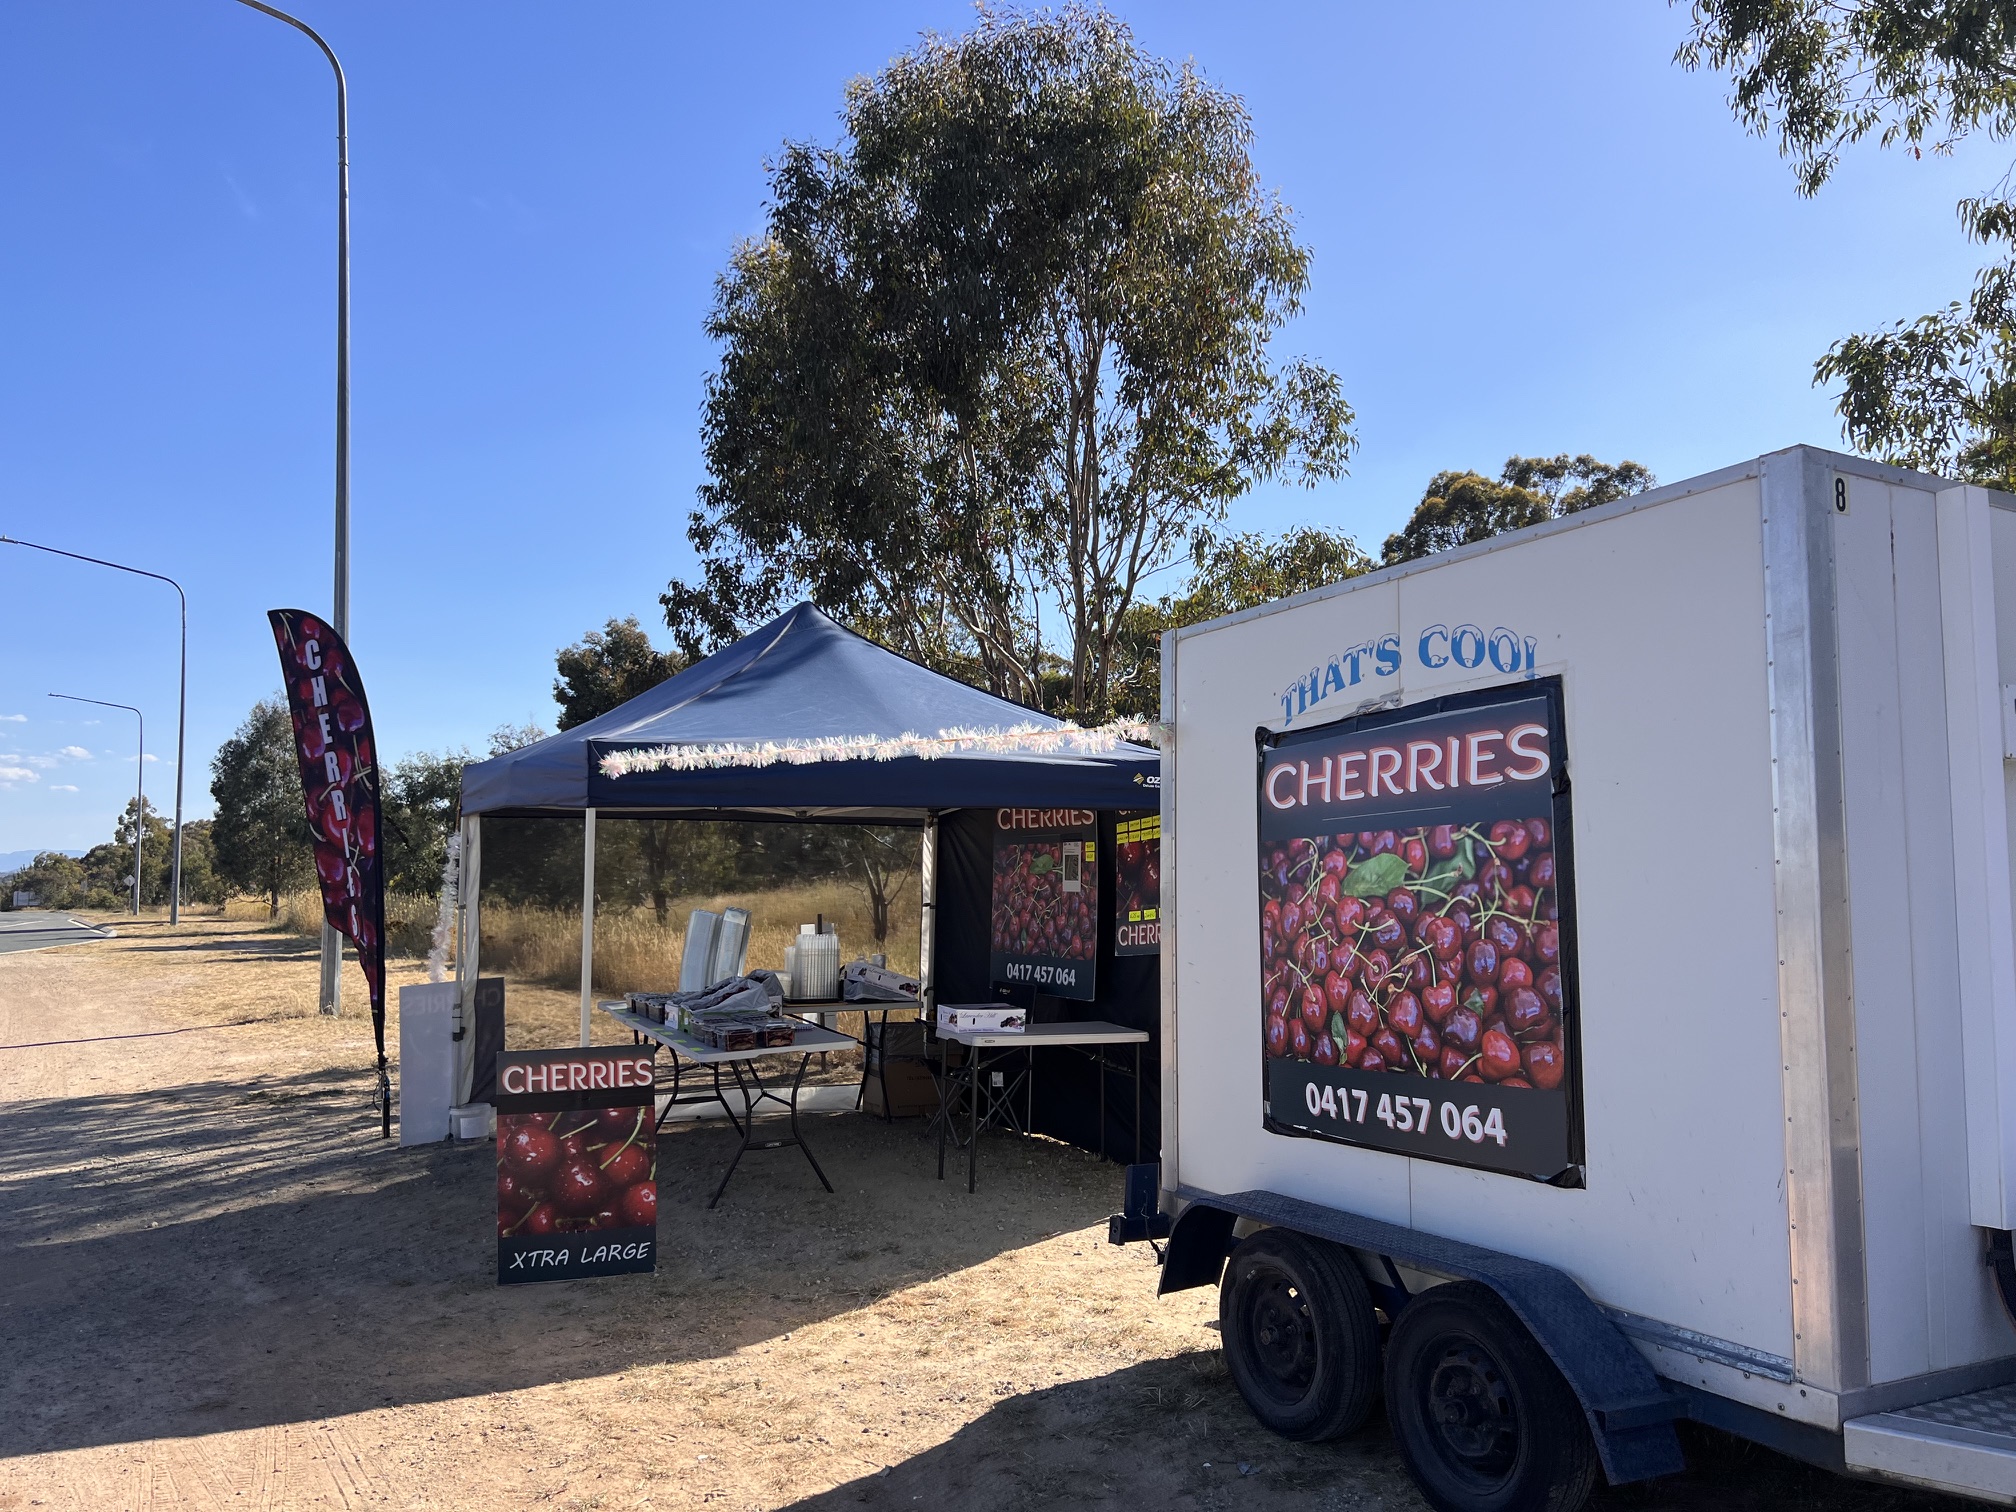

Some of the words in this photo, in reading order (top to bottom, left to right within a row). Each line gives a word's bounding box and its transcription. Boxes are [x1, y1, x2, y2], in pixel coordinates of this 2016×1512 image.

[1835, 477, 1846, 512] 8
[1281, 632, 1402, 726] THAT'S
[1266, 724, 1551, 810] CHERRIES
[304, 639, 360, 940] CHERRIES
[996, 808, 1095, 830] CHERRIES
[1006, 962, 1032, 981] 0417
[1034, 965, 1054, 984] 457
[1056, 967, 1076, 987] 064
[502, 1058, 653, 1094] CHERRIES
[1305, 1082, 1368, 1124] 0417
[1376, 1093, 1431, 1134] 457
[1440, 1101, 1508, 1147] 064
[509, 1249, 570, 1269] XTRA
[581, 1242, 651, 1264] LARGE
